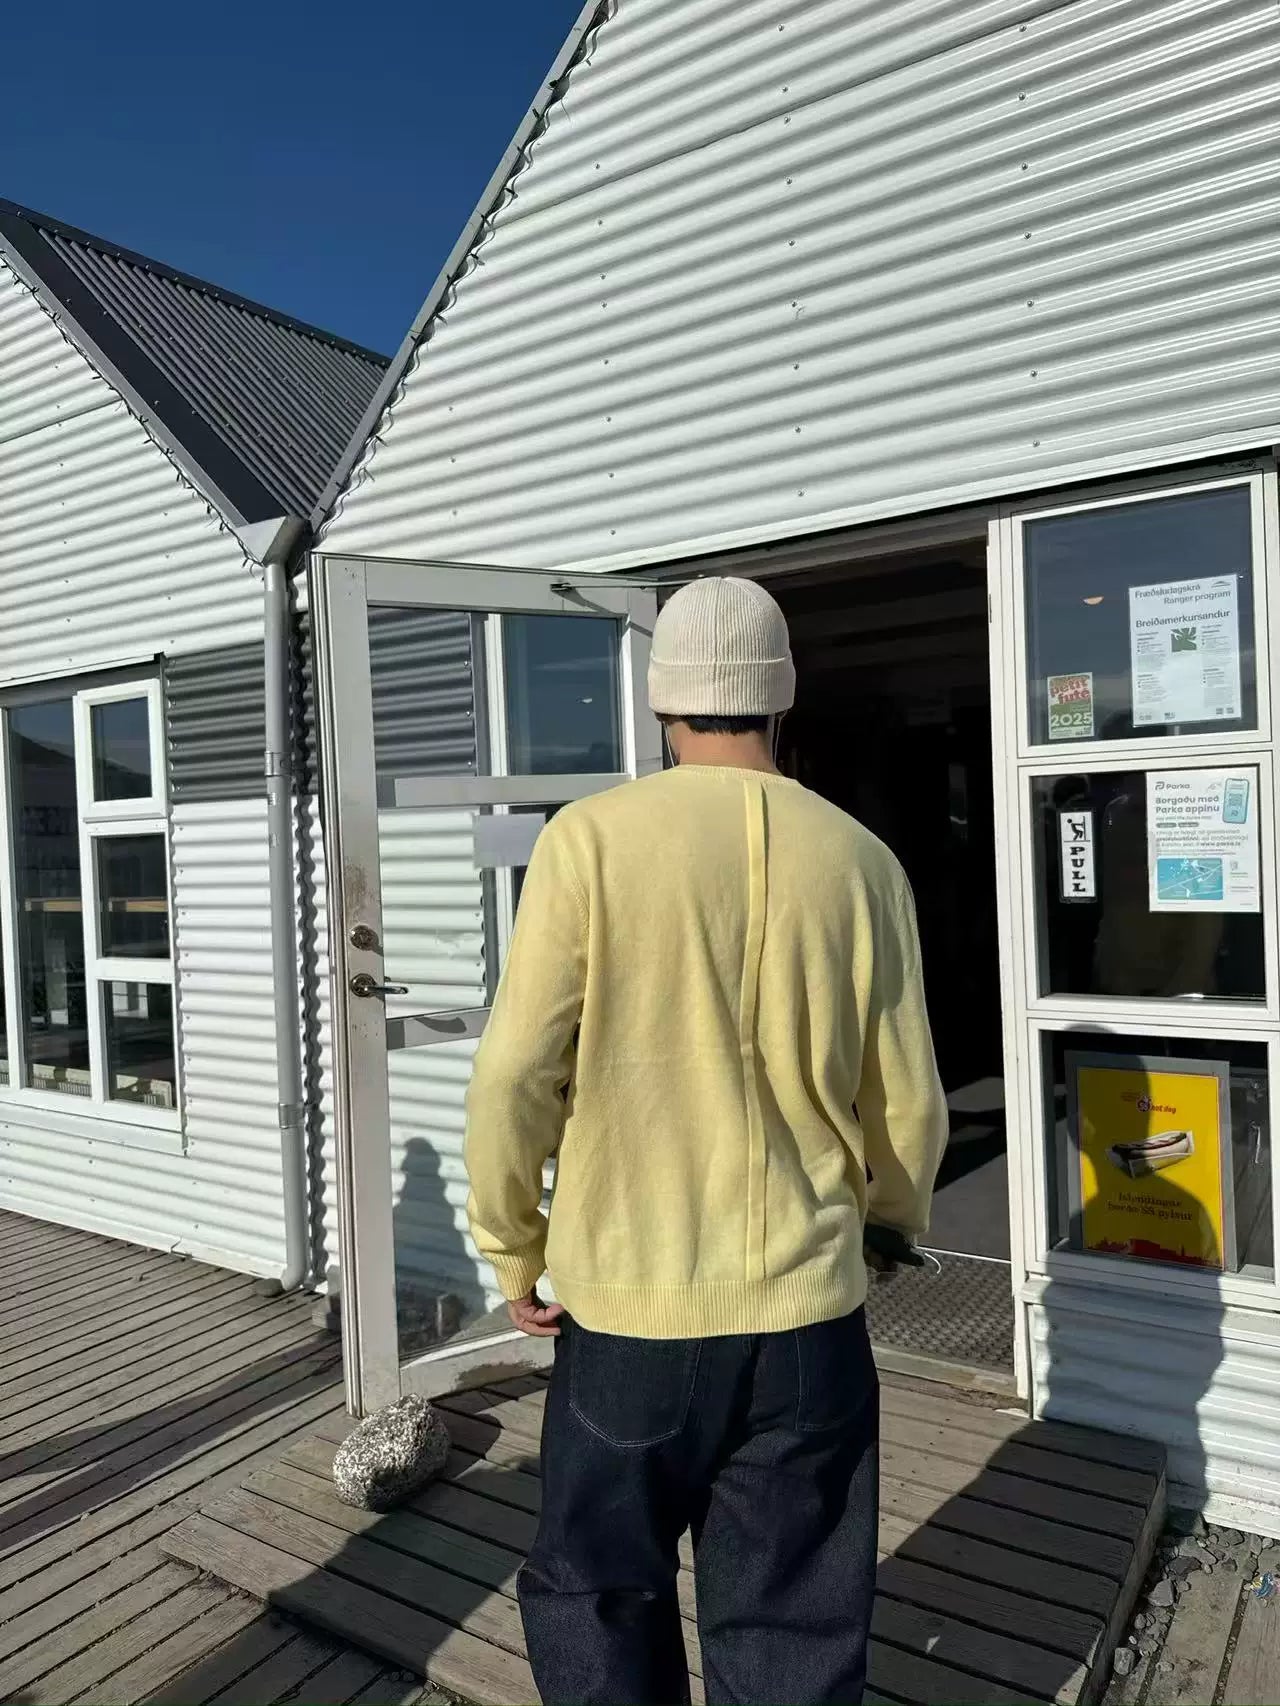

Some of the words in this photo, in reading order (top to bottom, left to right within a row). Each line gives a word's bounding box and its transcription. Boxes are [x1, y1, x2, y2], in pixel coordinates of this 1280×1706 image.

[1164, 595, 1193, 605] Ranger
[1195, 591, 1231, 602] program
[1136, 610, 1230, 628] Breiðamerkursandur
[1051, 712, 1092, 727] 2025
[1156, 806, 1183, 814] Parka
[1185, 804, 1220, 815] appinu
[1070, 846, 1086, 892] PULL
